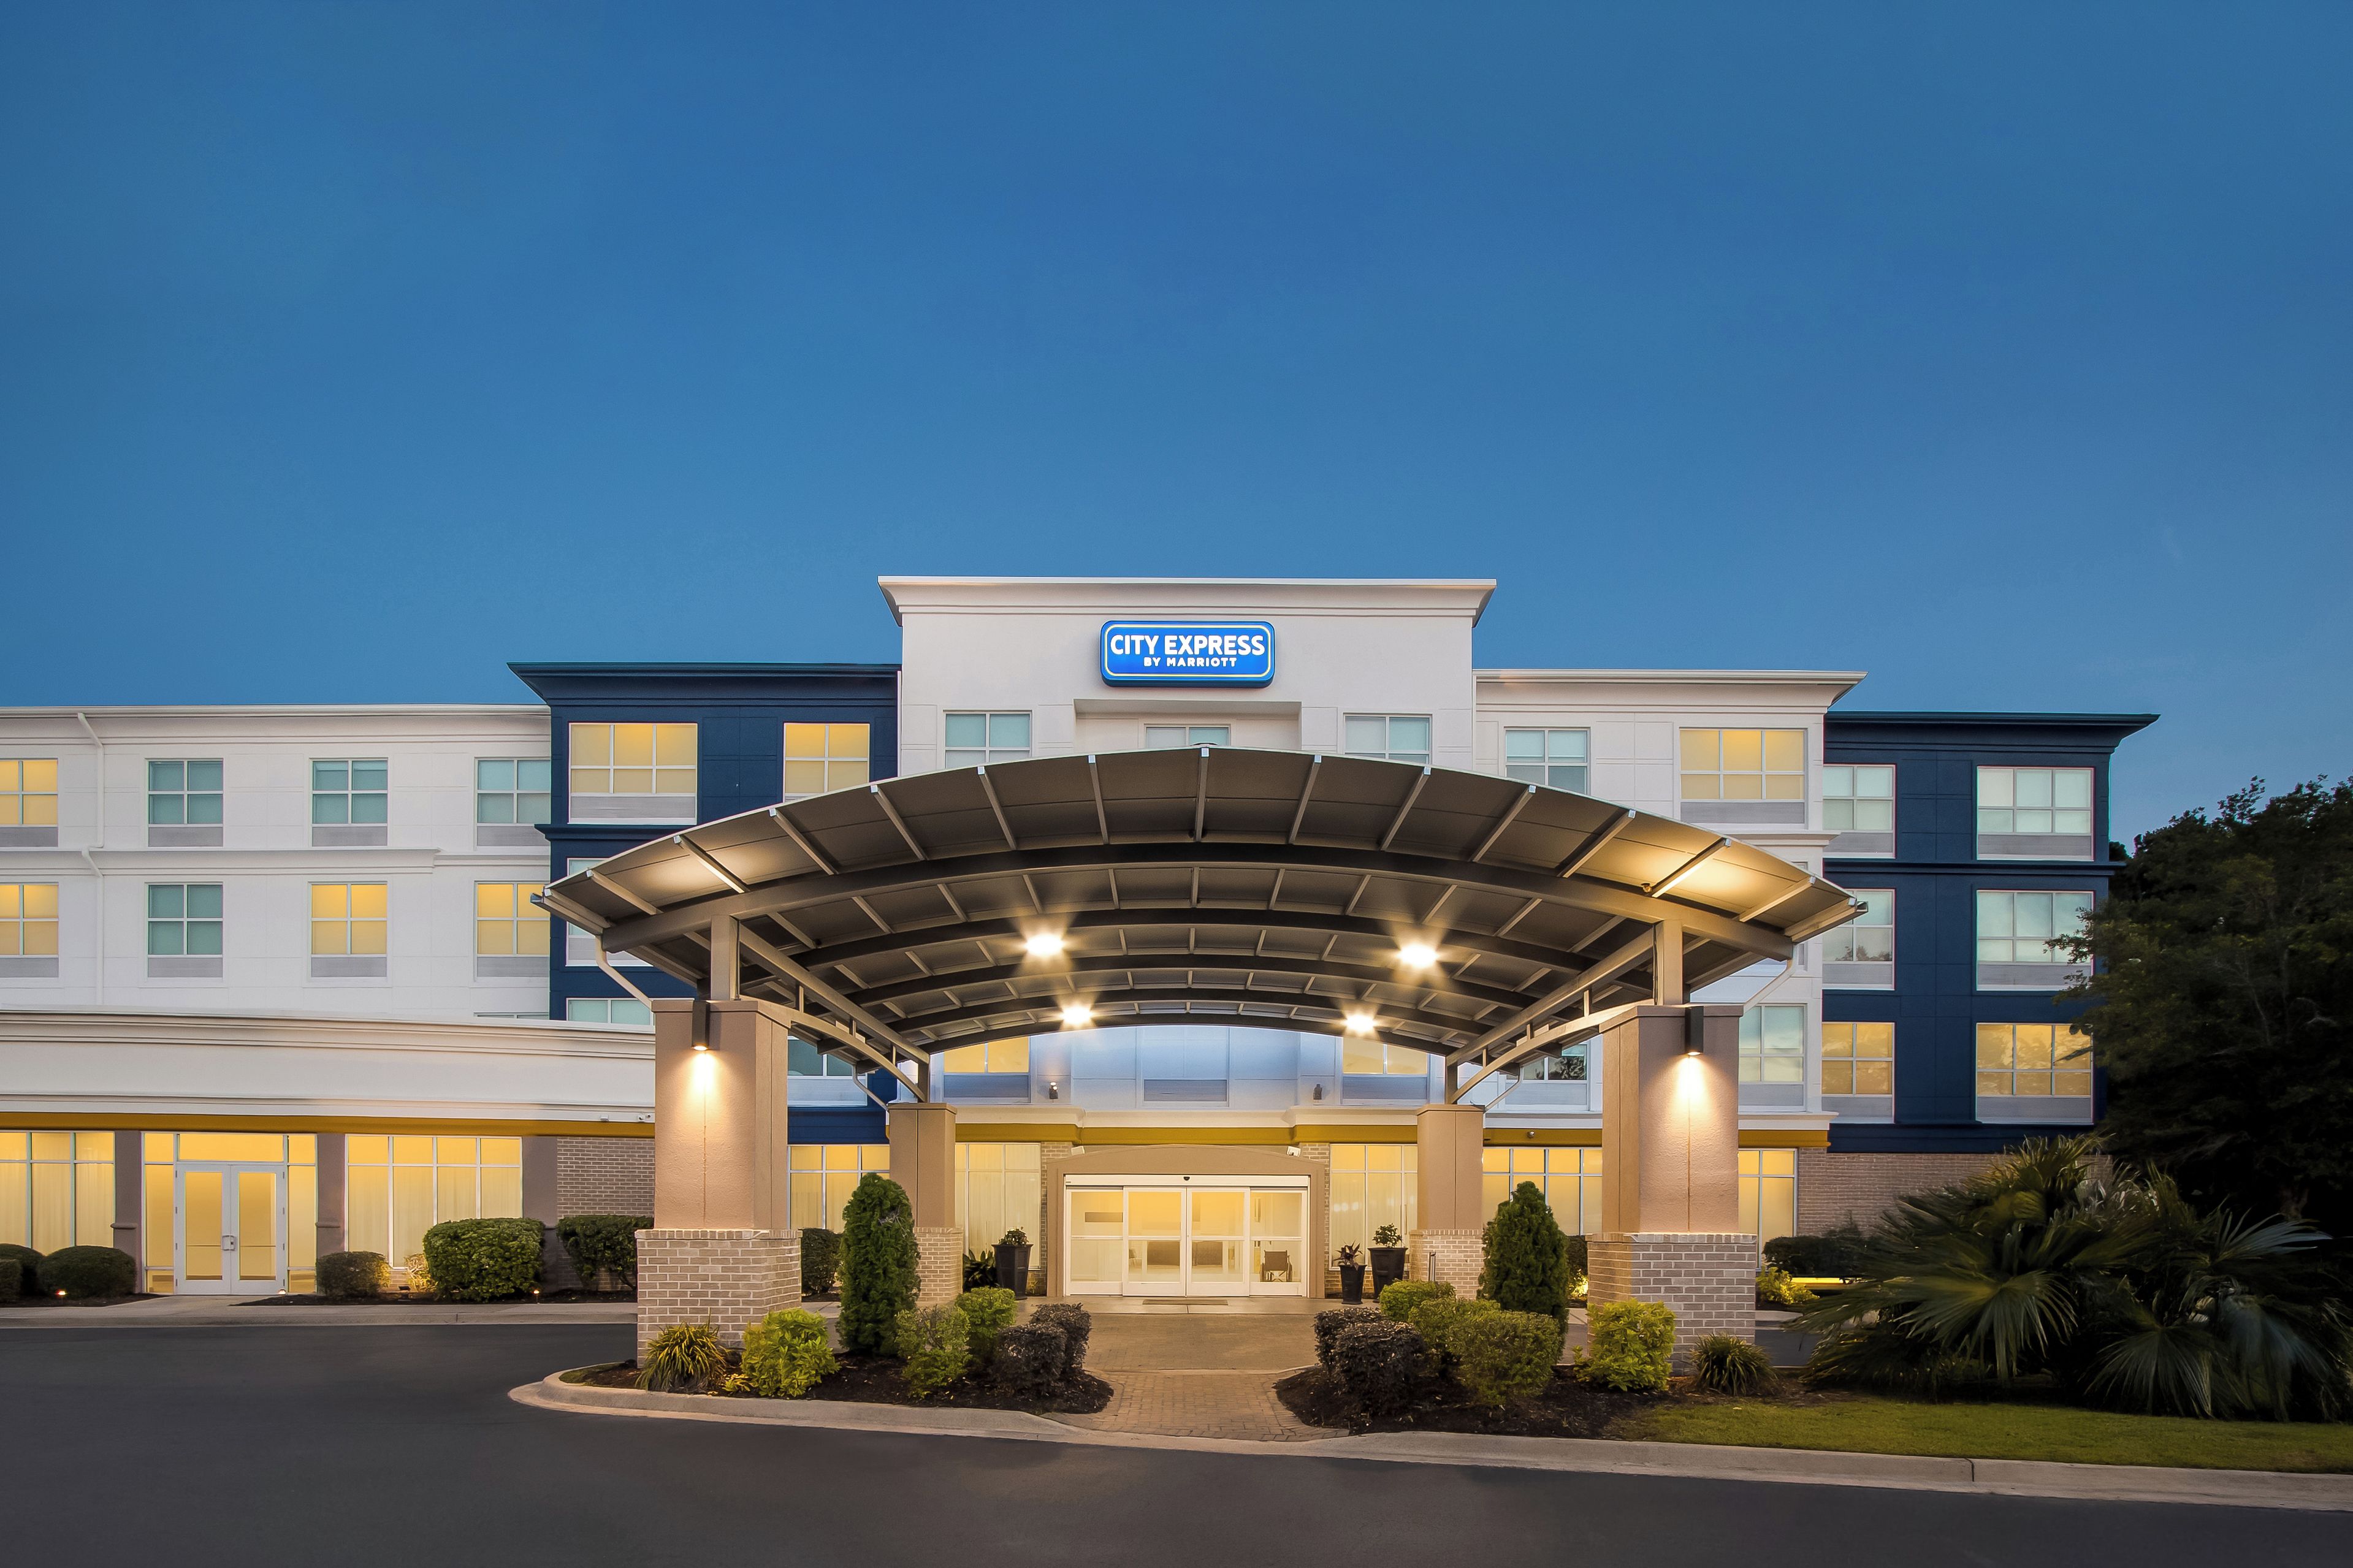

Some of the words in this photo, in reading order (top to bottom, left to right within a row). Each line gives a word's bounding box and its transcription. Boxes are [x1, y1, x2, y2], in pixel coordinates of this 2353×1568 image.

[1110, 634, 1159, 655] CITY
[1164, 635, 1265, 655] EXPRESS
[1143, 657, 1161, 667] BY
[1166, 657, 1237, 667] MARRIOTT
